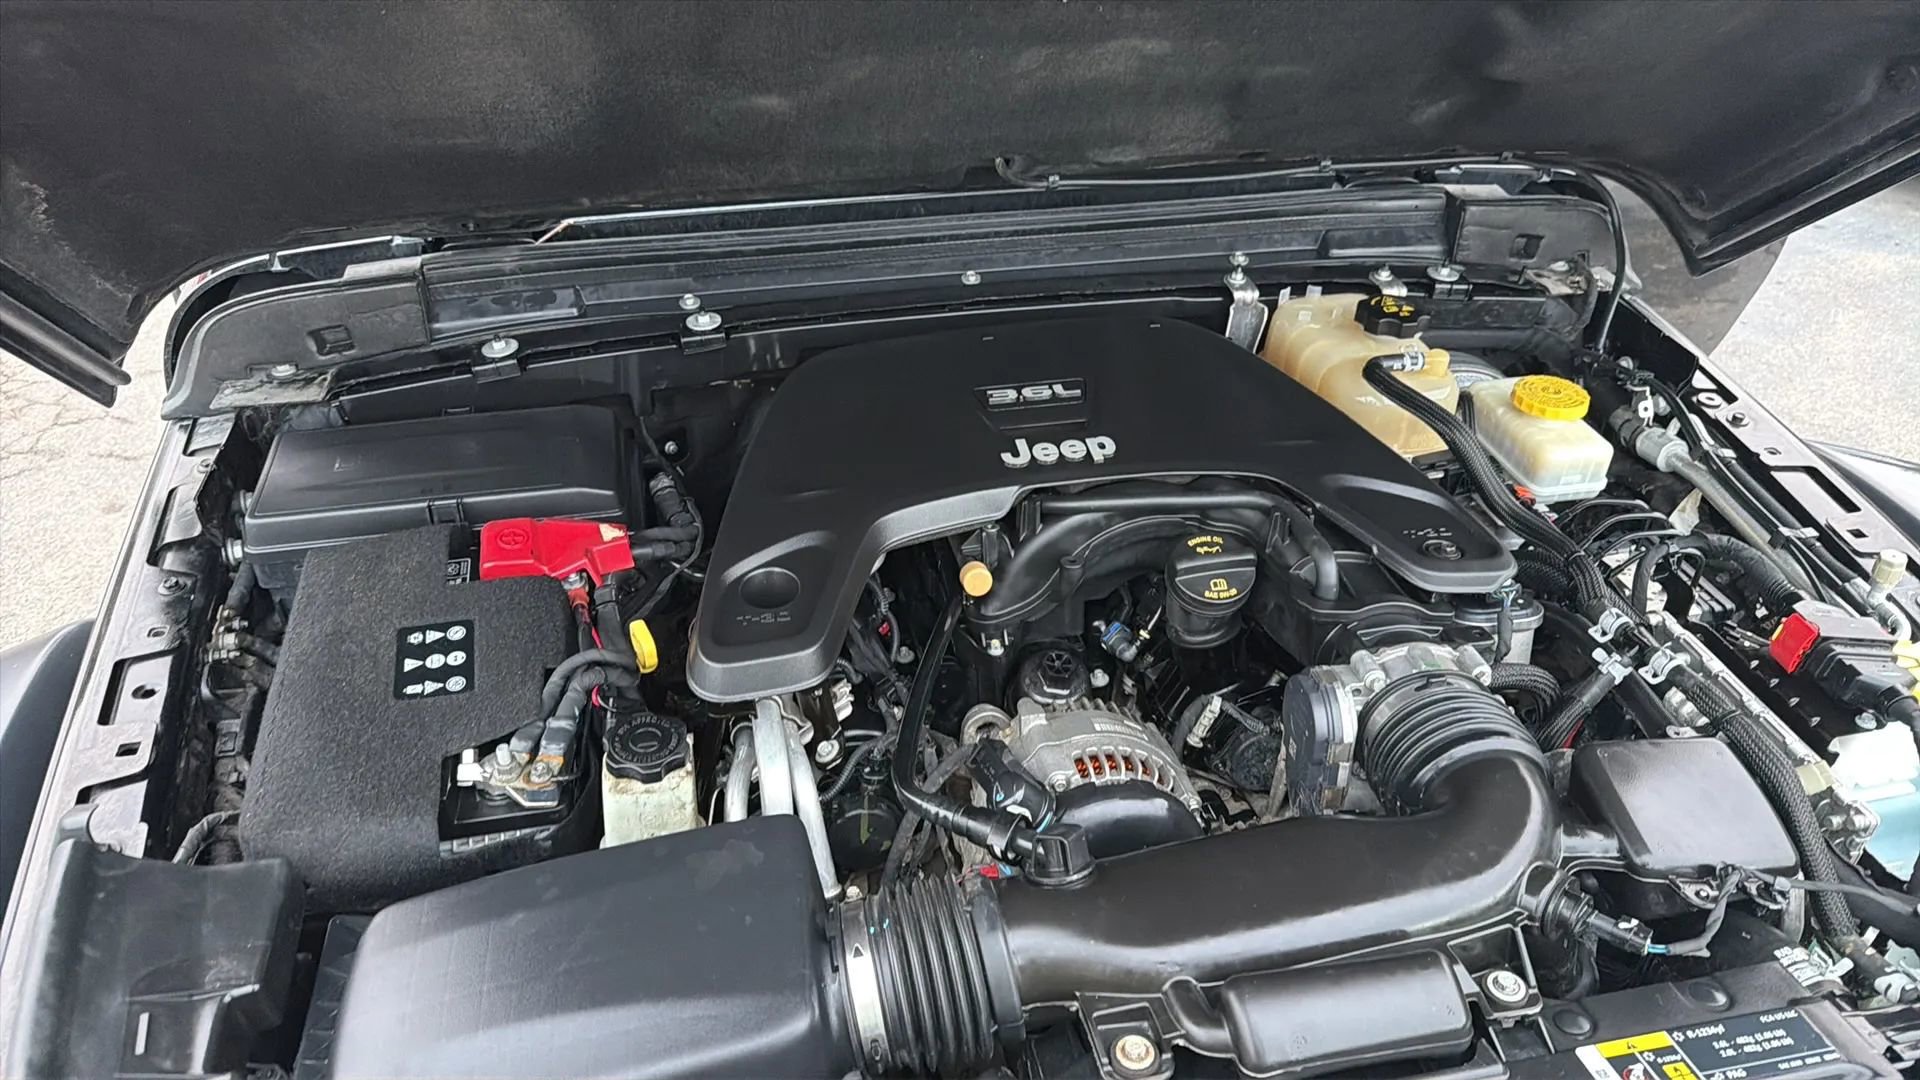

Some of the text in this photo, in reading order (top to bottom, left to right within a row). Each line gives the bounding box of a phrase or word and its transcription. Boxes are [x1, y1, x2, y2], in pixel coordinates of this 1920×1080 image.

[986, 383, 1081, 405] 3.6L
[1000, 435, 1116, 469] Jeep
[1187, 535, 1224, 547] ENGINE OIL
